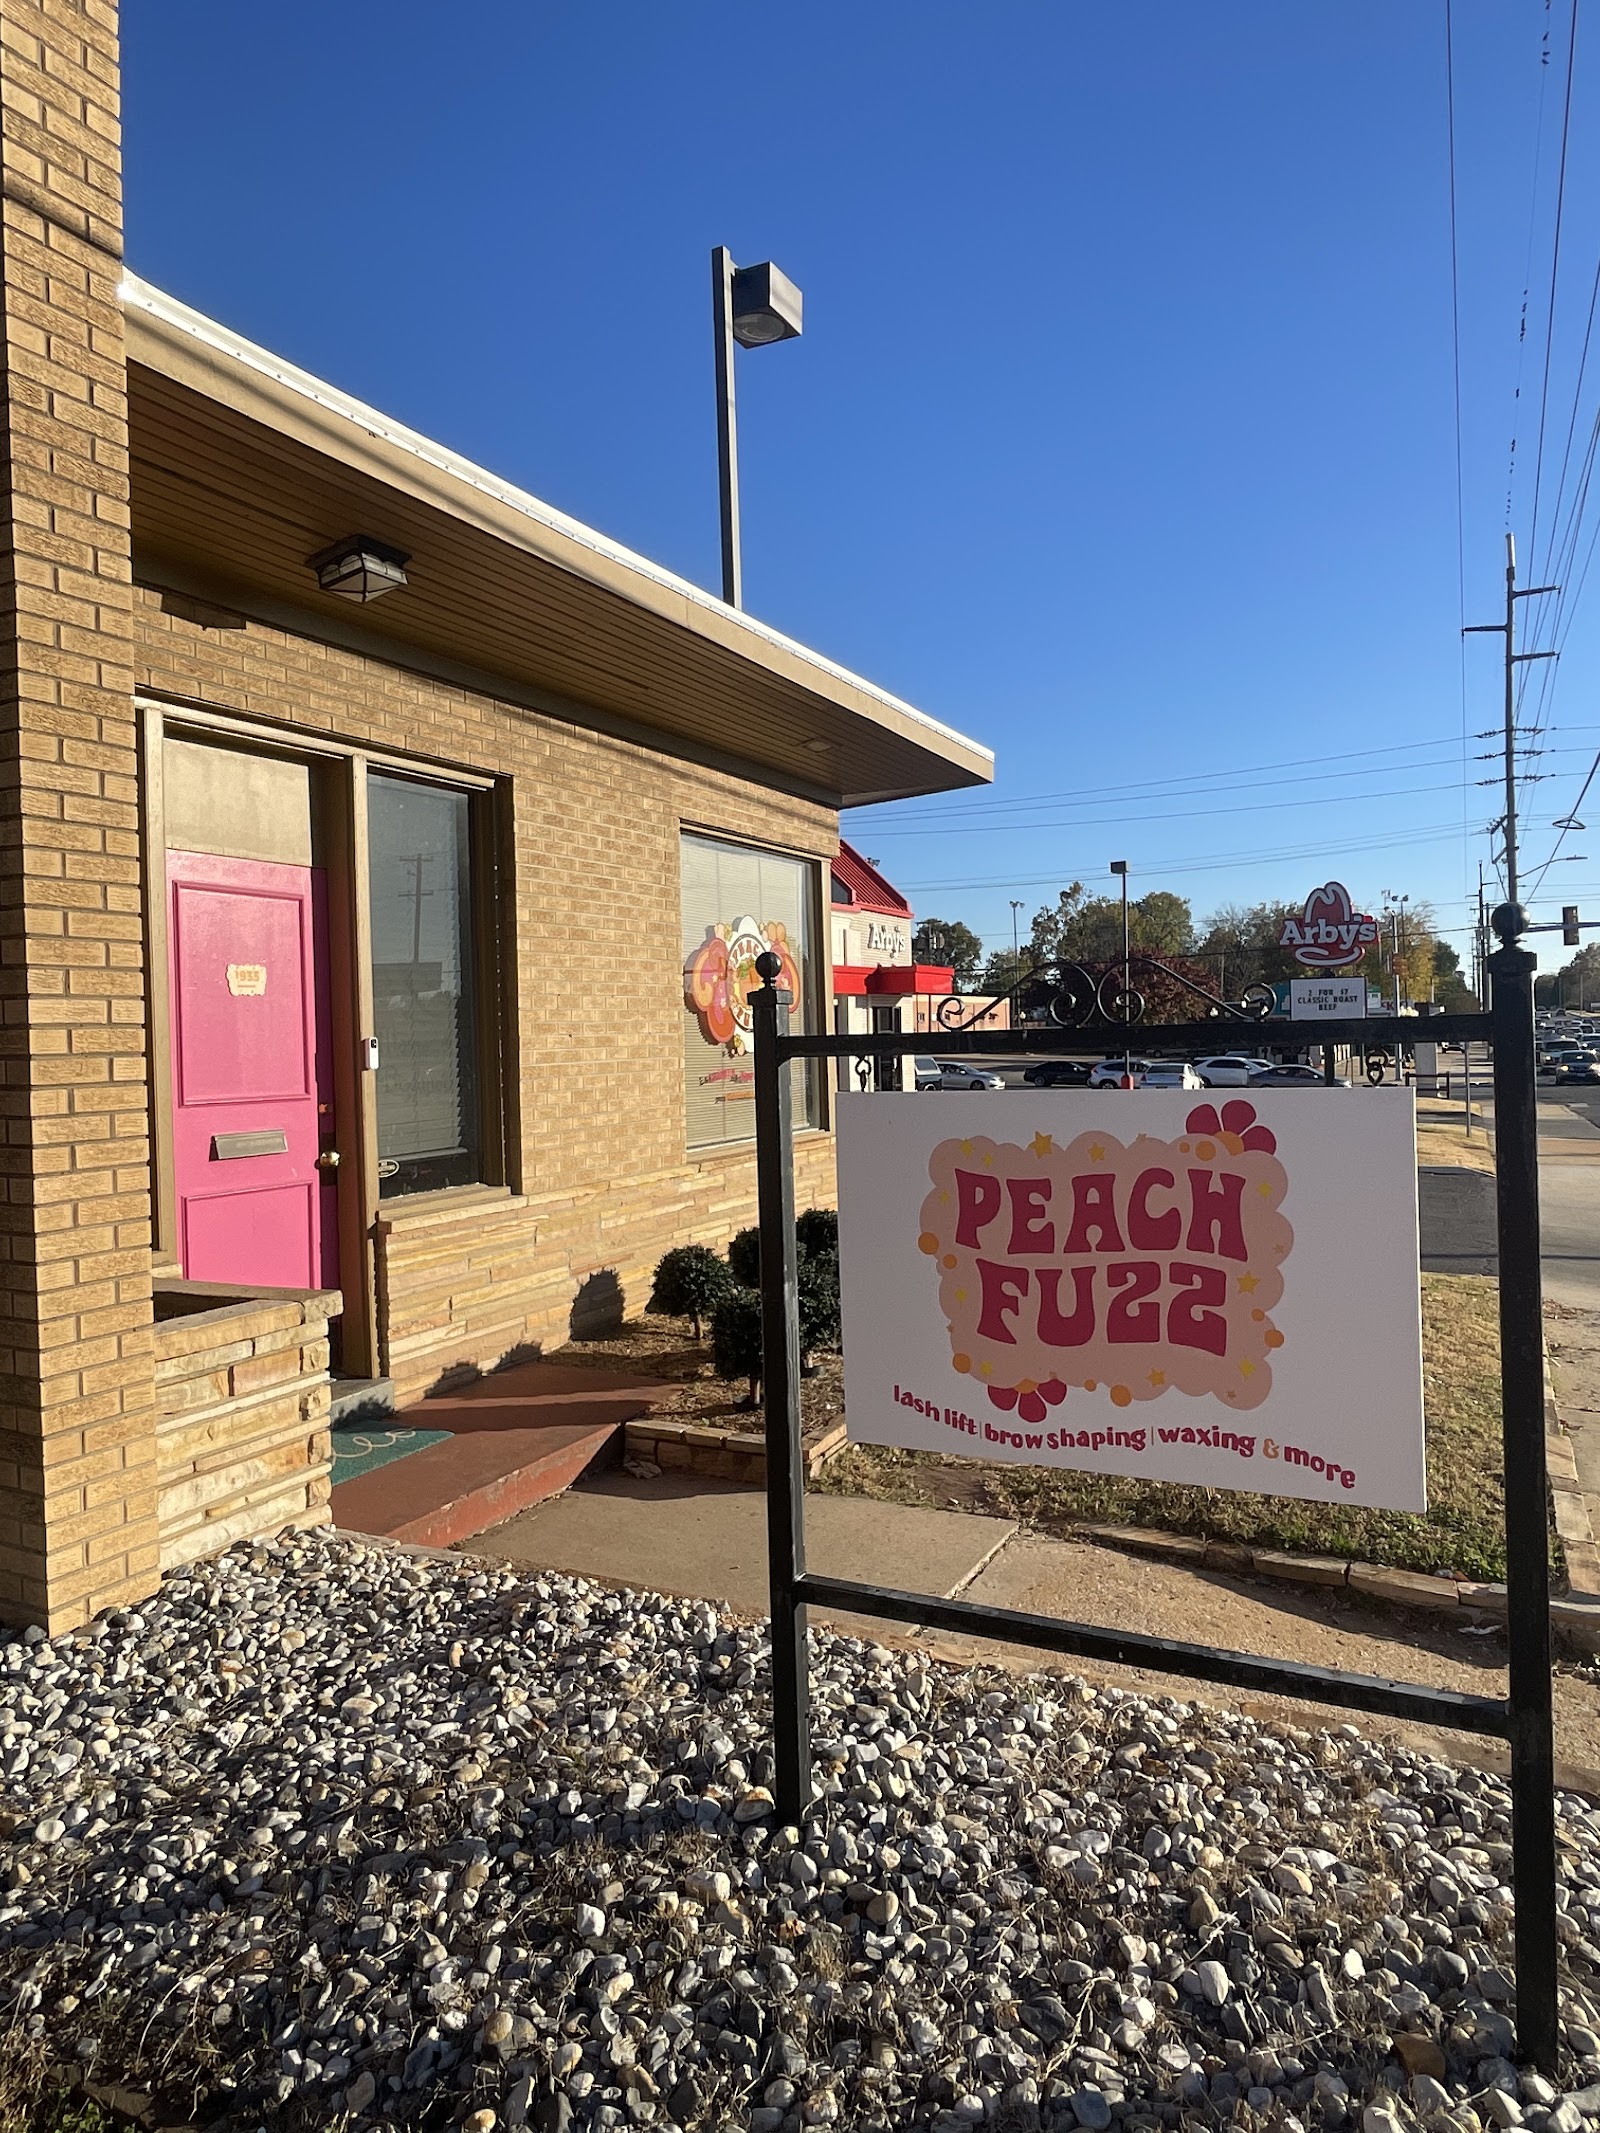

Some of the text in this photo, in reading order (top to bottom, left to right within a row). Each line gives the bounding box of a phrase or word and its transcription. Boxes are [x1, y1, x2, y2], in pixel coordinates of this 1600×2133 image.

[1280, 914, 1377, 949] Arby's
[1297, 995, 1358, 1004] CLASSIC ROAST
[1318, 1003, 1338, 1011] BEEF
[954, 1167, 1249, 1263] PEACH
[976, 1258, 1228, 1358] FUZZ
[893, 1384, 1356, 1489] lash lift brow shaping waxing & more
